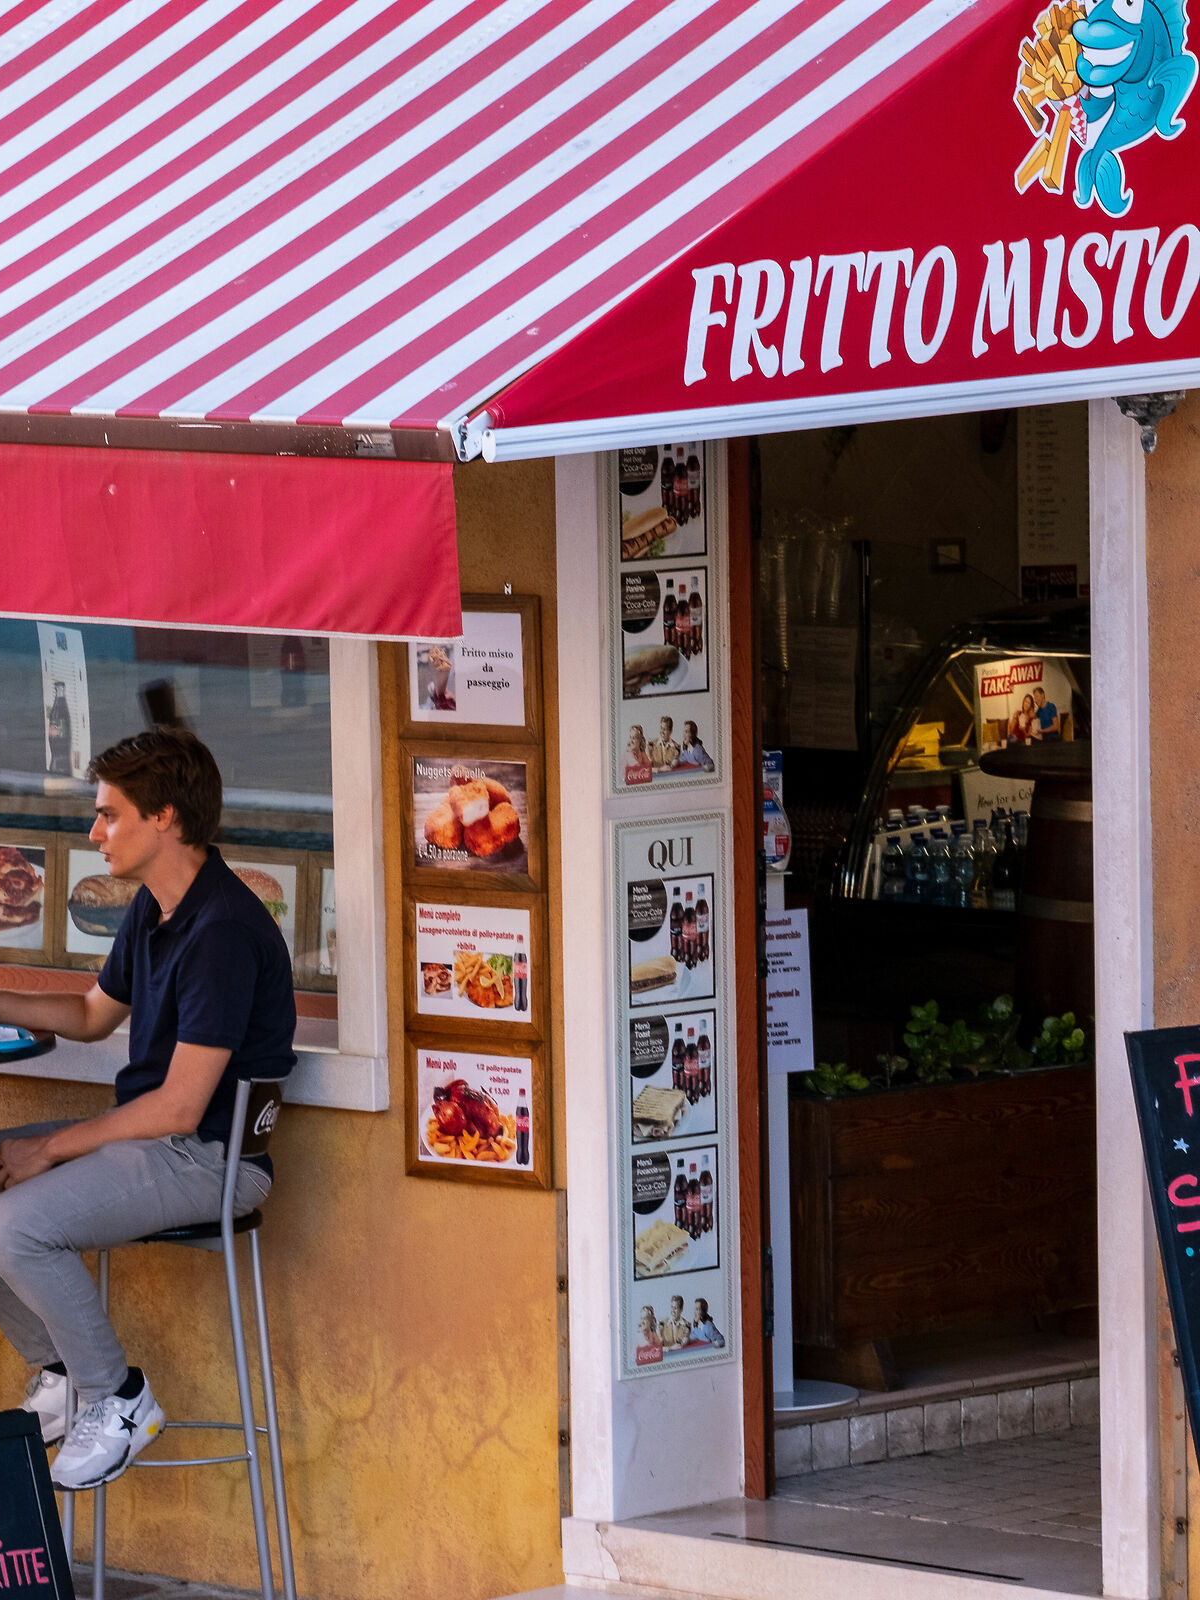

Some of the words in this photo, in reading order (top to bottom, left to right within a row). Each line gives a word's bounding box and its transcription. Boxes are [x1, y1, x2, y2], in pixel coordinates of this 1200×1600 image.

[683, 244, 958, 387] FRITTO
[972, 223, 1200, 359] MISTO
[461, 647, 486, 658] Fritto
[488, 648, 514, 659] misto
[482, 662, 494, 673] da
[467, 677, 511, 691] passeggio
[983, 676, 1011, 695] TAKE
[1011, 664, 1041, 684] AWAY
[416, 762, 452, 780] Nuggets
[454, 767, 462, 779] di
[464, 767, 487, 782] pollo
[648, 836, 694, 872] QUI
[632, 894, 653, 902] Panino
[435, 910, 461, 923] completo
[472, 929, 478, 937] di
[634, 1031, 651, 1039] Toast
[443, 1059, 457, 1072] pollo
